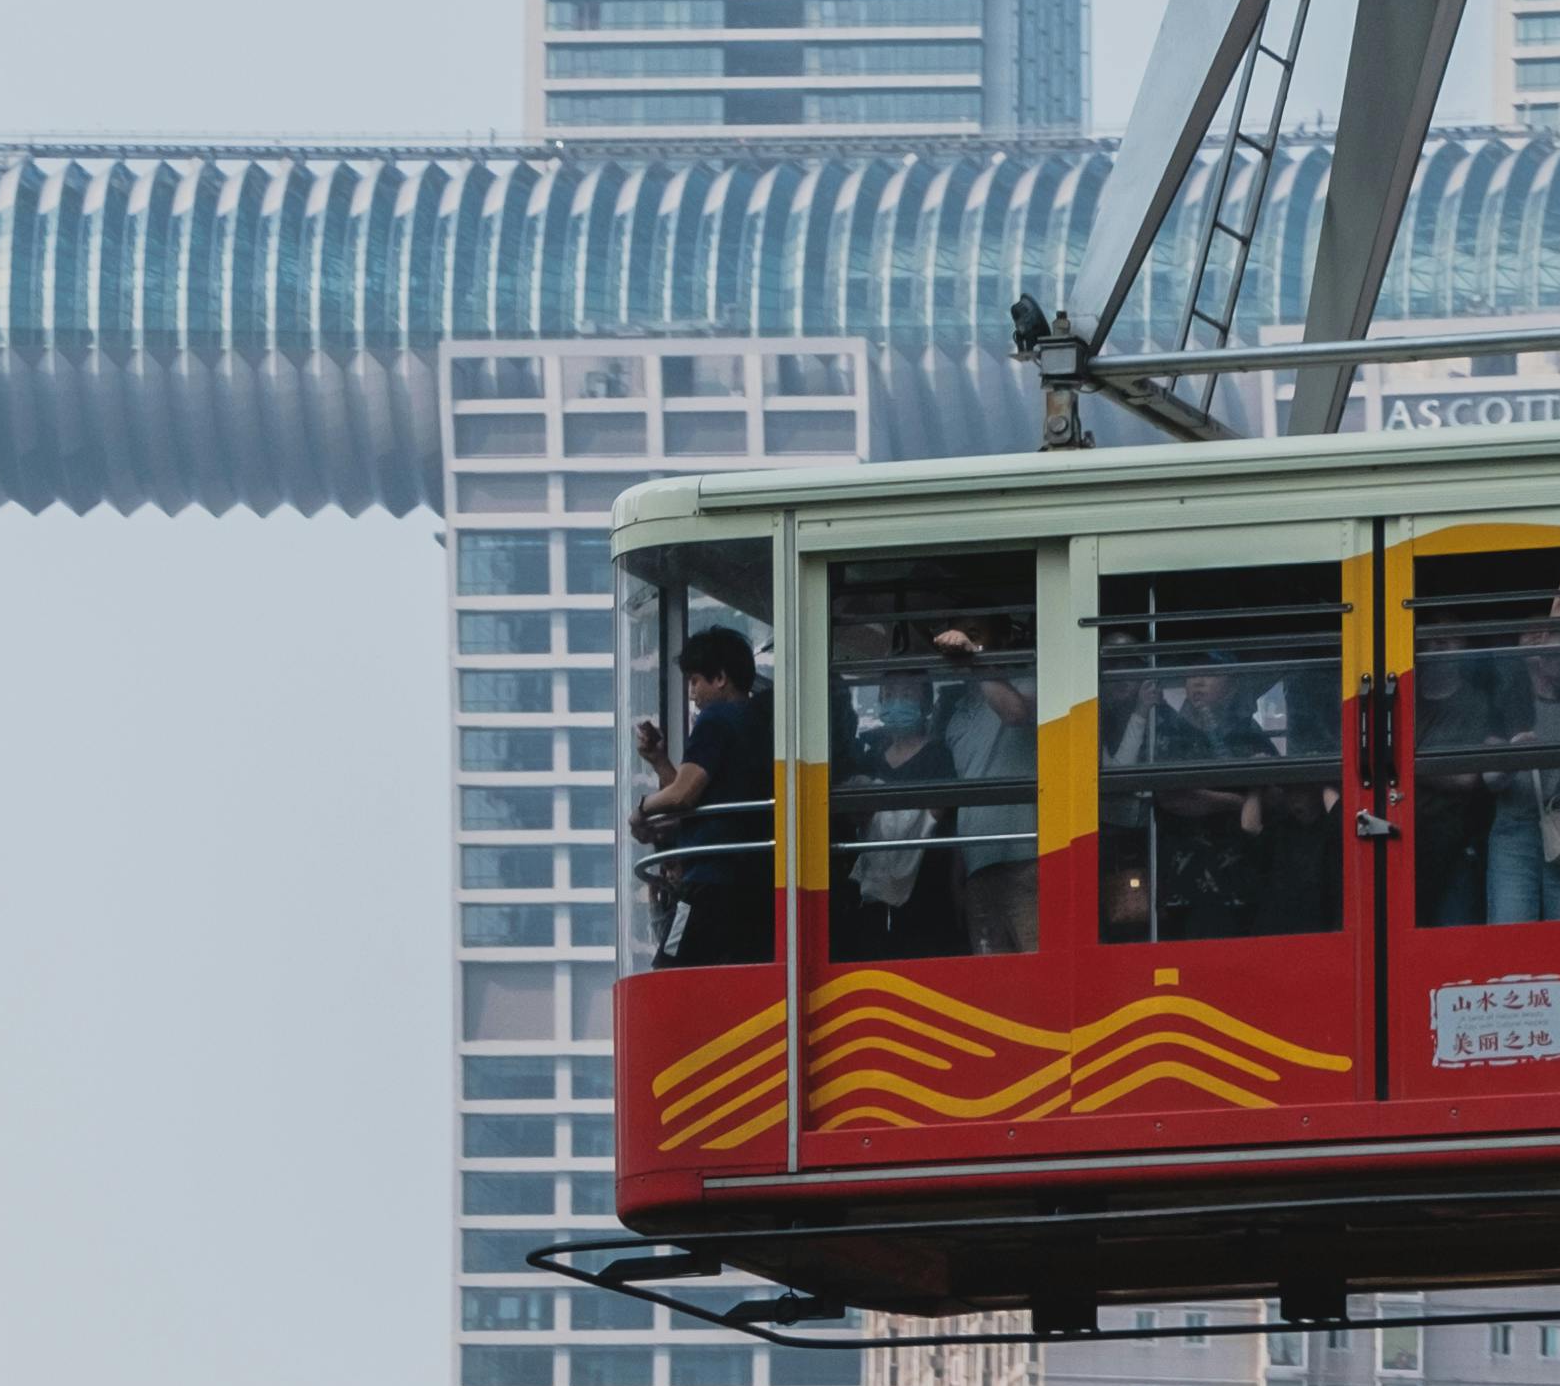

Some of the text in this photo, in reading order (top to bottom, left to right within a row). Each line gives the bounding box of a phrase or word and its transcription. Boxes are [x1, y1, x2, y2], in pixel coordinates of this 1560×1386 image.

[1386, 394, 1560, 431] ASCOTT
[1452, 987, 1552, 1013] 山水之城
[1453, 1029, 1554, 1055] 美丽之地
